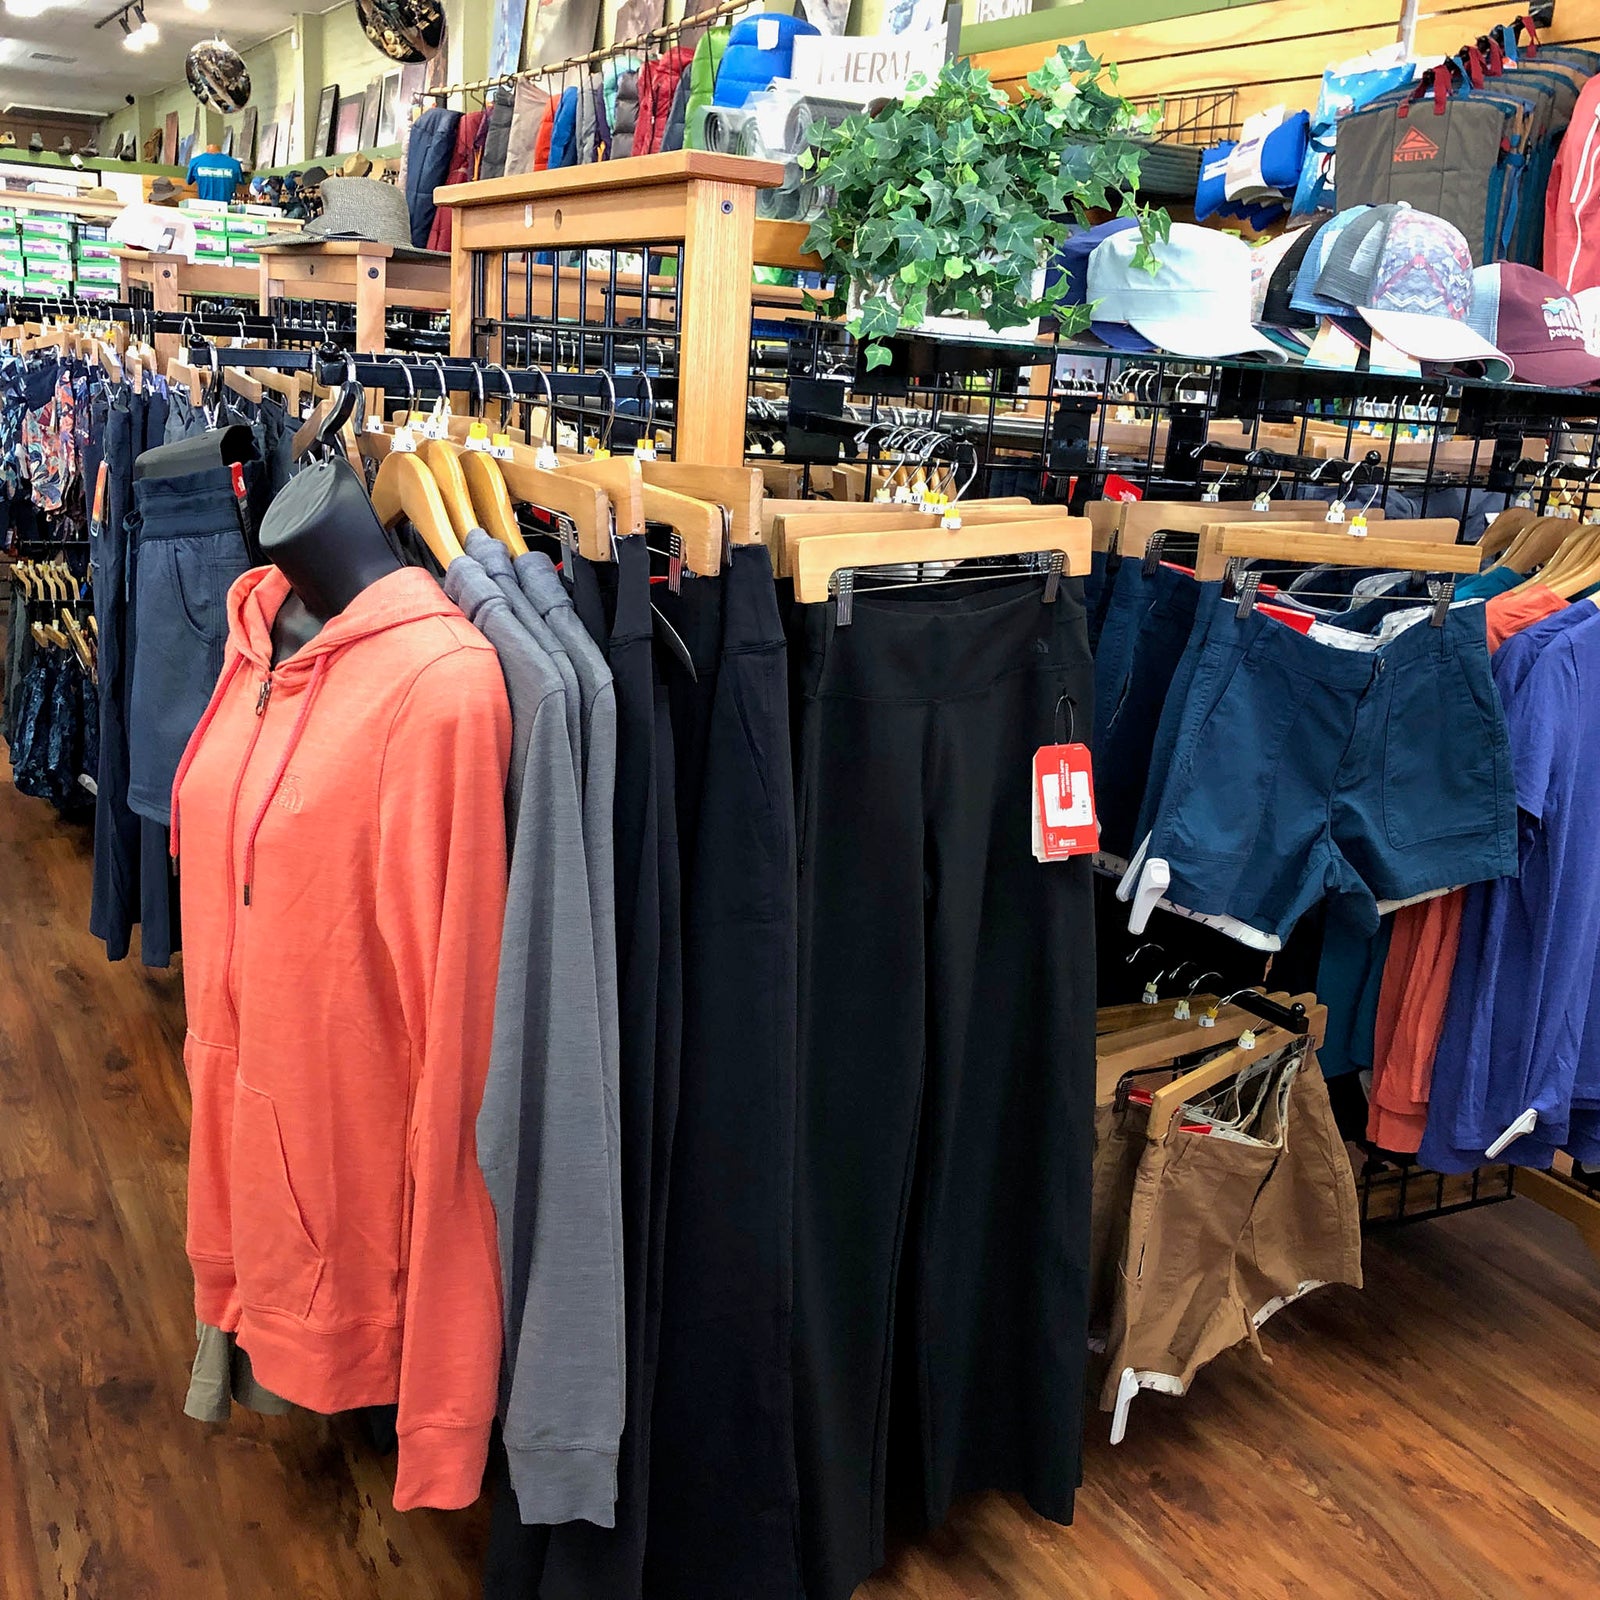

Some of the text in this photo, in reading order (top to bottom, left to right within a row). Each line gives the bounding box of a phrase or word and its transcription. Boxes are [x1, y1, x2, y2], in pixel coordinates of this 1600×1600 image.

[1393, 150, 1438, 162] KELTY
[405, 443, 412, 451] S
[497, 448, 506, 457] M
